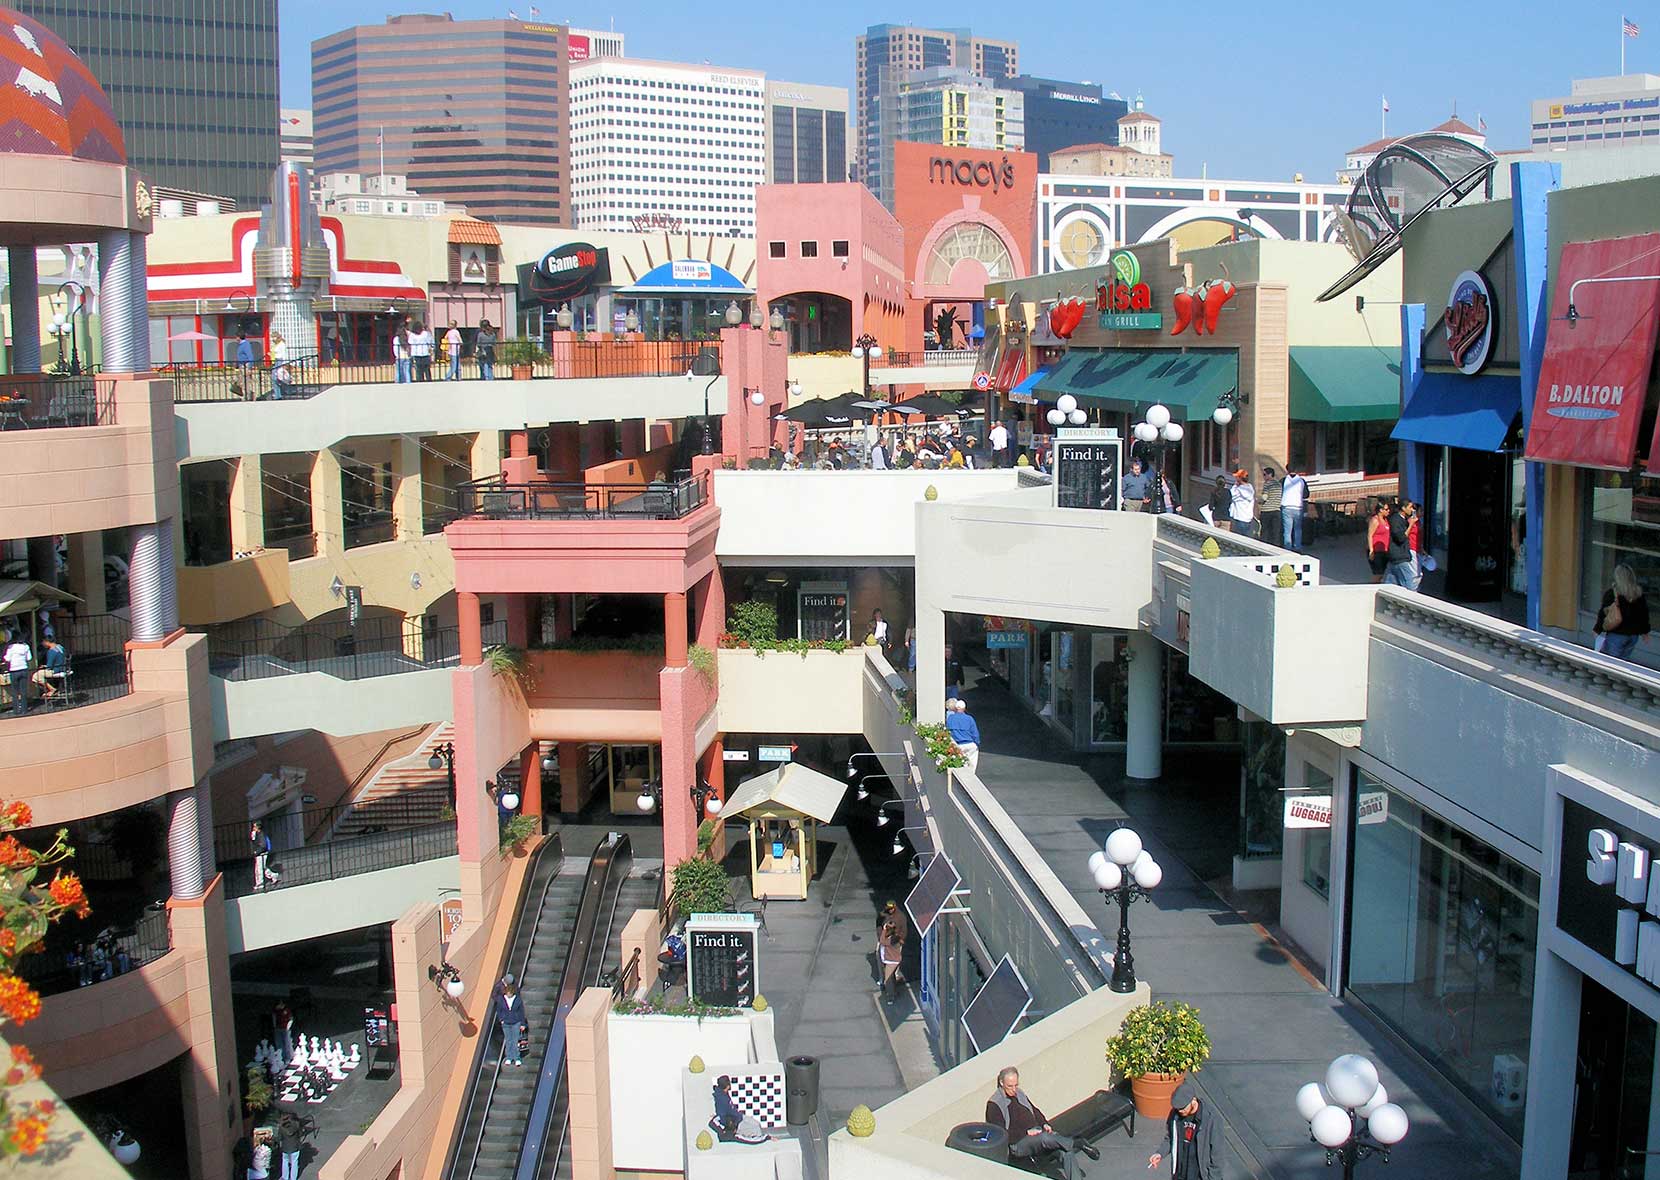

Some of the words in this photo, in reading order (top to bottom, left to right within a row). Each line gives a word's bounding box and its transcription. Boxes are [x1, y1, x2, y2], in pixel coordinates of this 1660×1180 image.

[710, 73, 729, 83] REED
[1053, 91, 1079, 101] MERRILL
[1079, 94, 1099, 105] LYNCH
[547, 250, 597, 274] GameStop
[1114, 316, 1140, 327] GRILL
[1063, 429, 1112, 437] DIRECTORY
[1062, 447, 1092, 460] Find
[1095, 447, 1108, 461] it.
[804, 596, 827, 606] Find
[990, 633, 1025, 642] PARK
[1290, 806, 1332, 824] LUGGAGE
[695, 934, 726, 947] Find
[730, 934, 743, 947] it.
